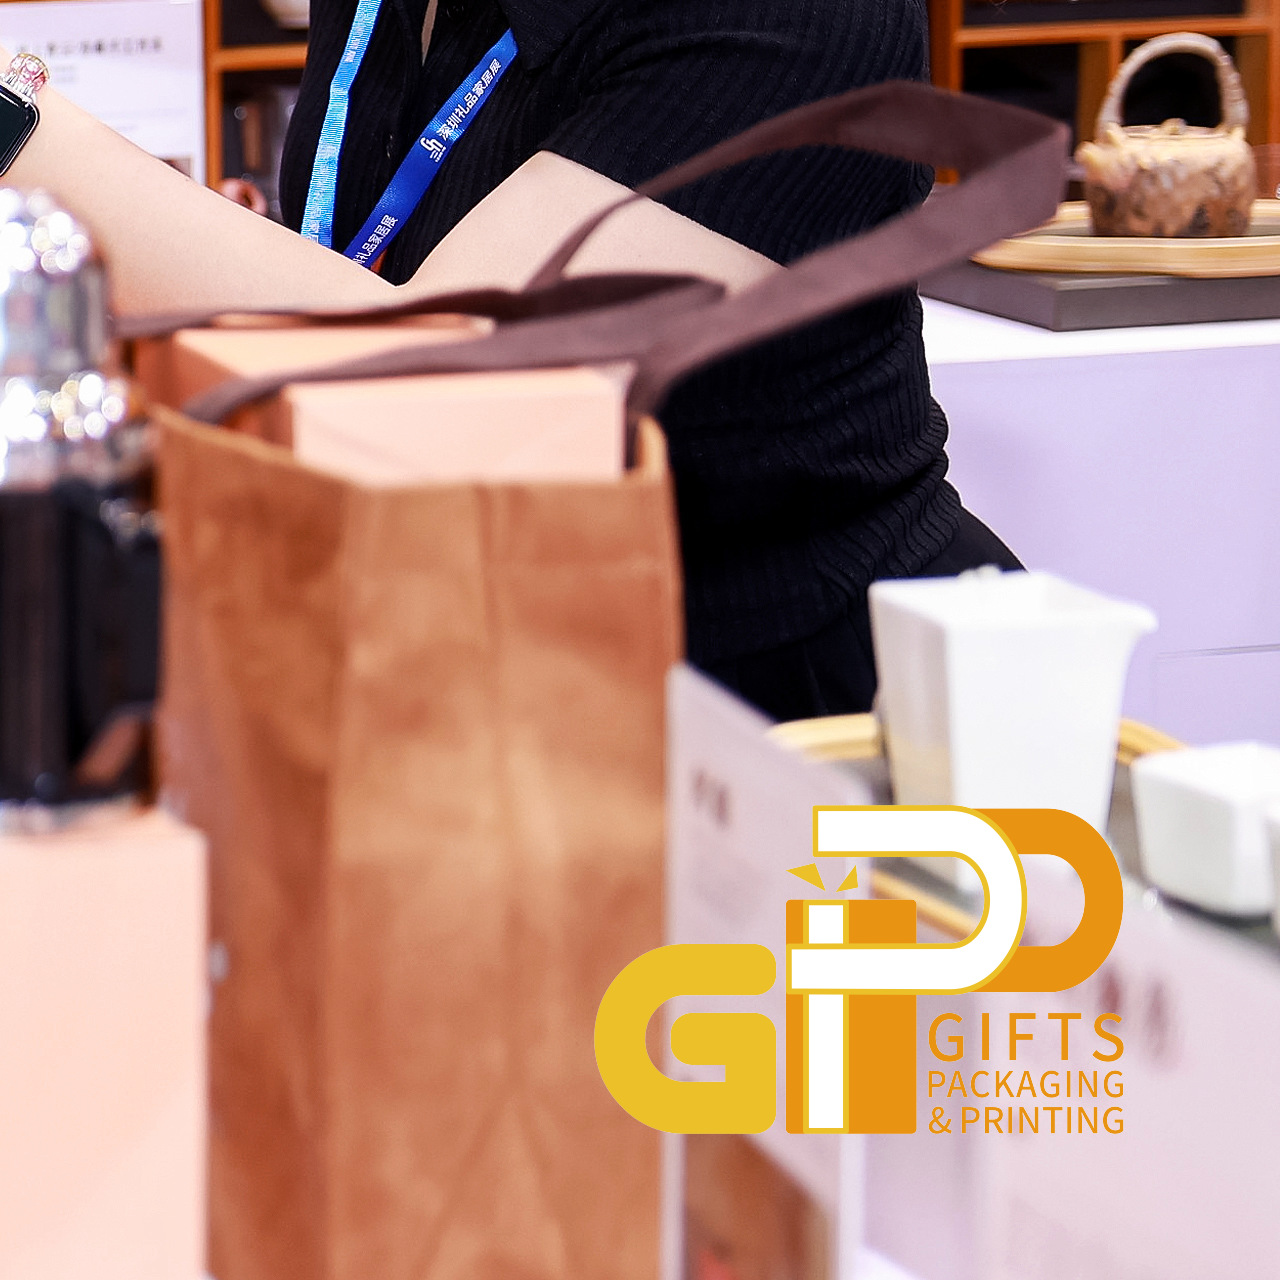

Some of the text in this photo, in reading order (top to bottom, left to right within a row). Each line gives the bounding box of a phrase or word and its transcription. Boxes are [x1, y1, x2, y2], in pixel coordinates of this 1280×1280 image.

[436, 58, 501, 141] 深圳礼品家居展
